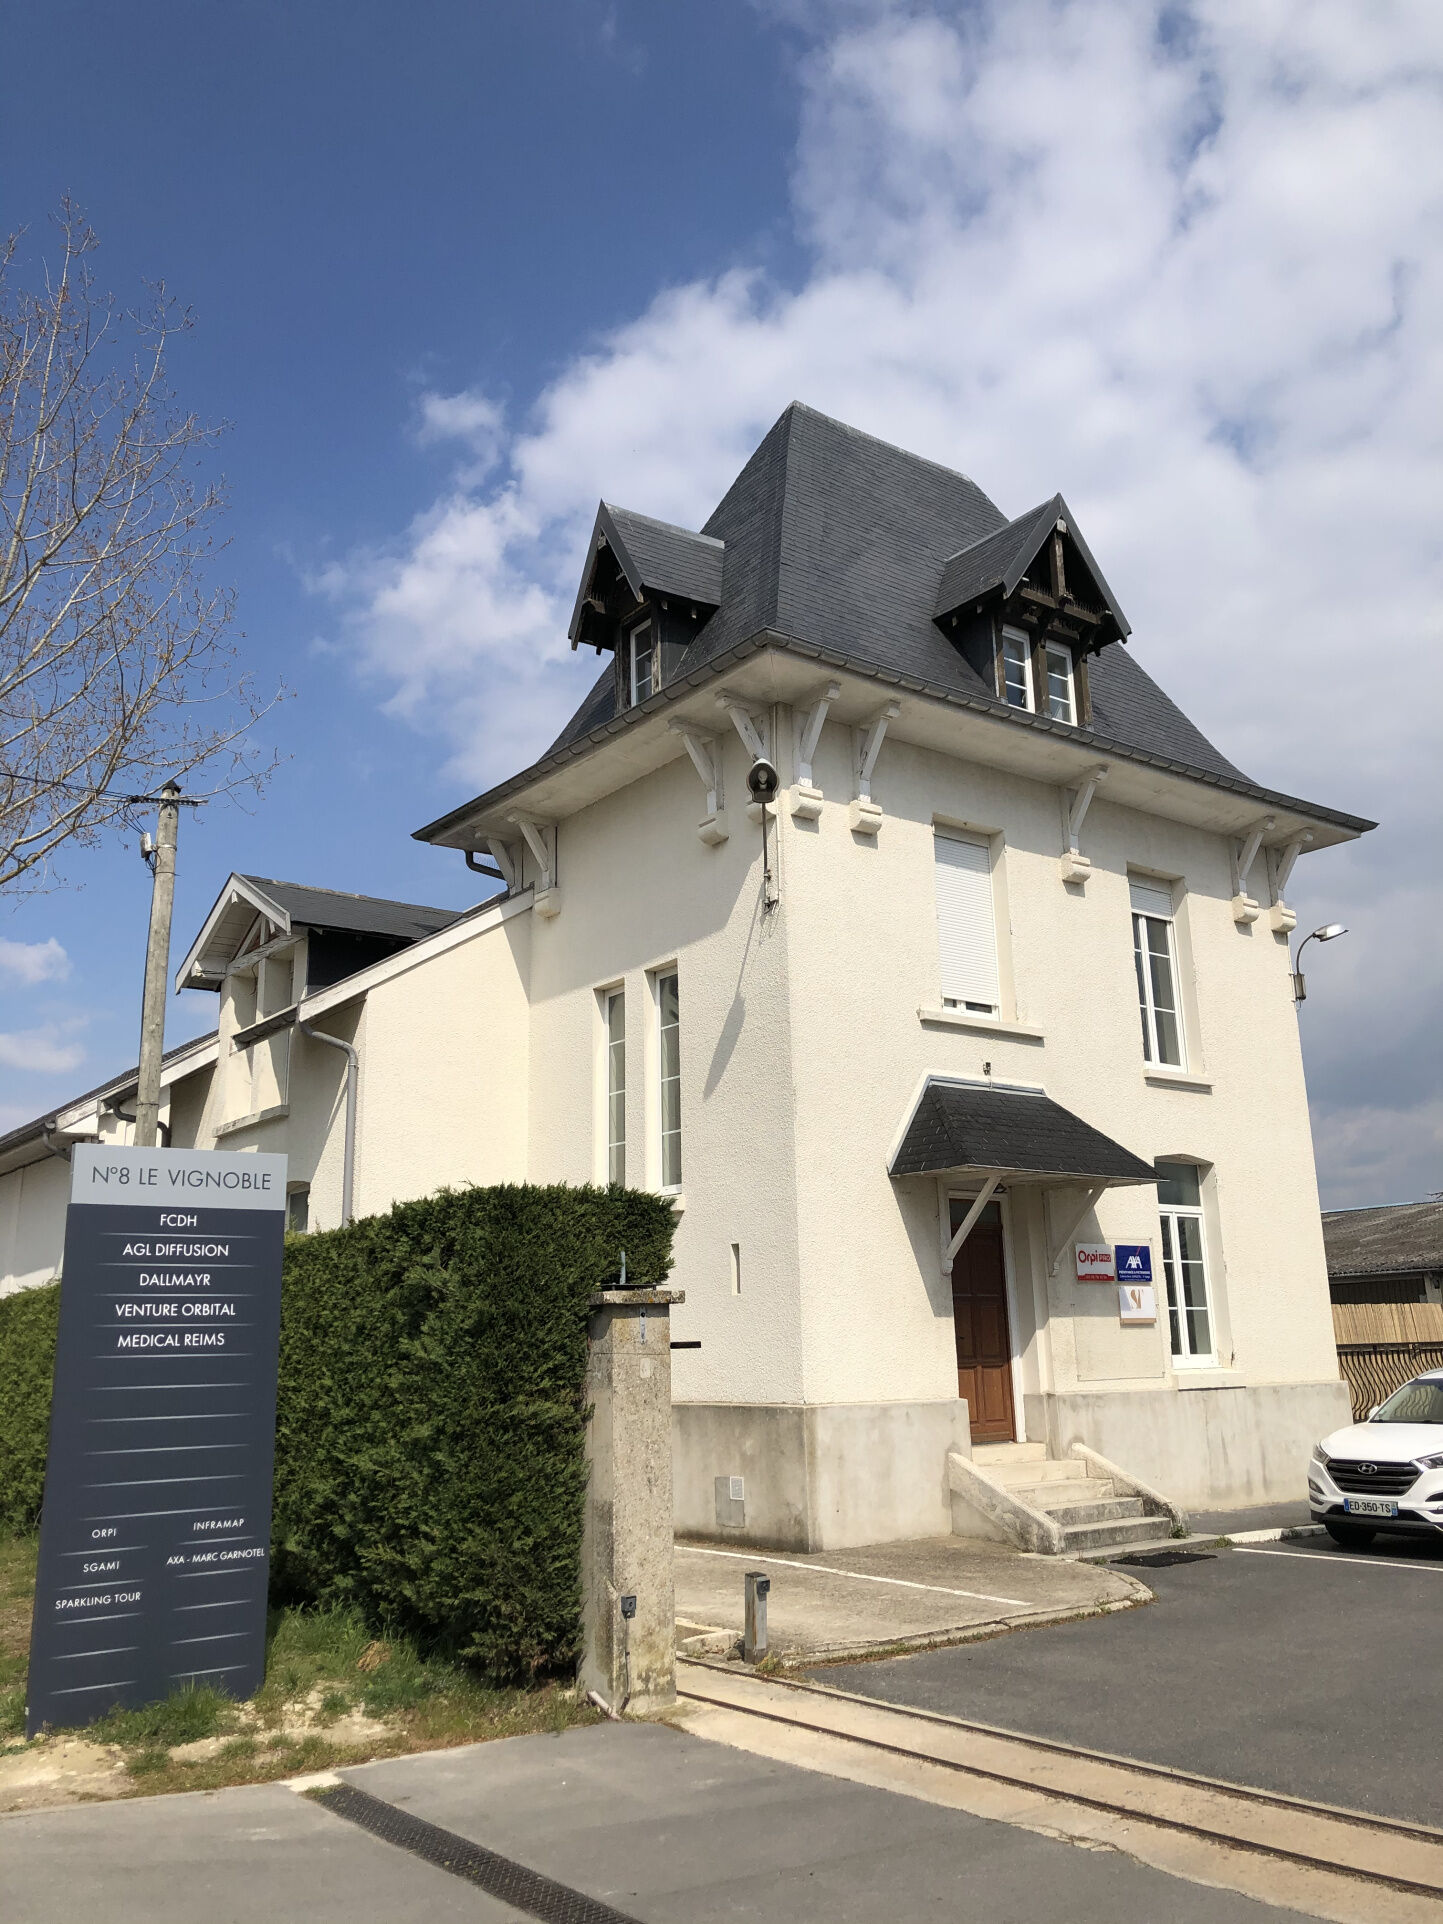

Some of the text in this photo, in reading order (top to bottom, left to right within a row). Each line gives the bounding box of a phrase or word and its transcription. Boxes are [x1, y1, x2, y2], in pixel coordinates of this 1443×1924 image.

[139, 1168, 159, 1186] LE
[168, 1169, 272, 1190] VIGNOBLE
[159, 1214, 198, 1227] FCDH
[122, 1243, 230, 1257] AGL DIFFUSION
[1078, 1250, 1098, 1266] Orpi
[1126, 1256, 1142, 1268] AXA
[139, 1273, 211, 1287] DALLMAYR
[115, 1303, 236, 1317] VENTURE ORBITAL
[117, 1333, 226, 1348] MEDICAL REIMS
[193, 1518, 245, 1531] INFRAMAP
[91, 1528, 117, 1539] ORPI
[166, 1555, 185, 1566] AXA
[192, 1552, 219, 1563] MARC
[219, 1548, 265, 1561] GARNOTEL
[82, 1561, 120, 1573] SGAMI
[55, 1591, 142, 1610] SPARKLING TOUR
